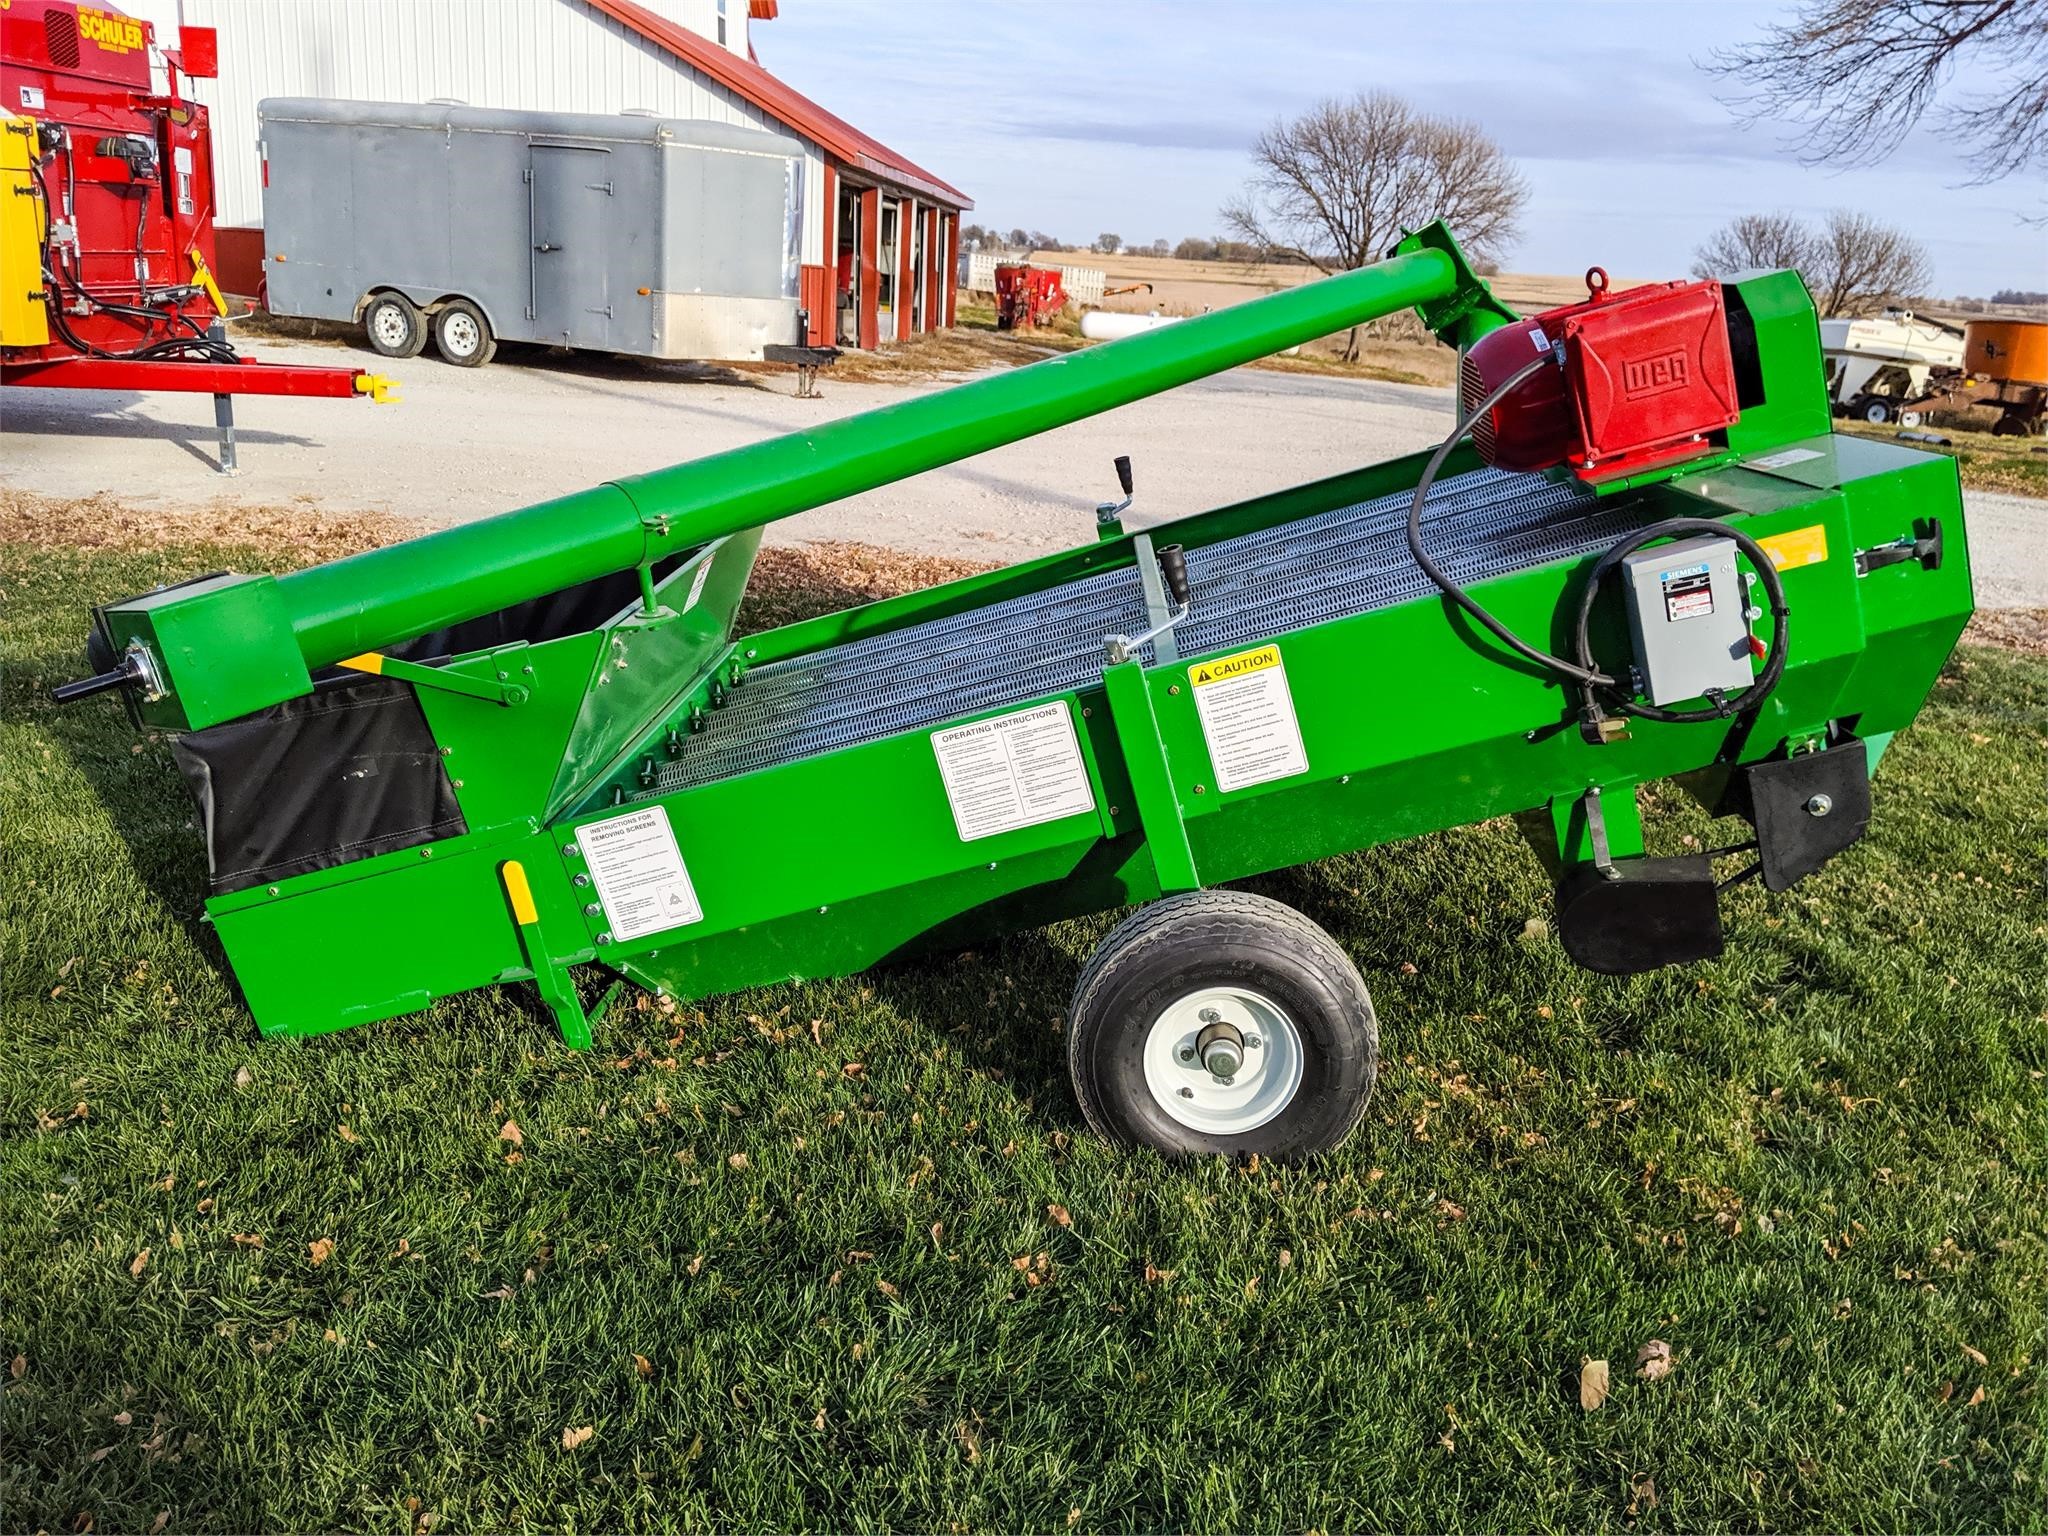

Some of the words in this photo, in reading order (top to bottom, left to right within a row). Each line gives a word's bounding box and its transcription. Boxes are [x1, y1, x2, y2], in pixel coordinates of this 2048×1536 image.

[79, 14, 144, 51] SCHULER
[1667, 566, 1702, 579] SIEMENS
[1214, 653, 1273, 677] CAUTION
[942, 725, 992, 743] OPERATING
[994, 708, 1058, 730] INSTRUCTIONS
[590, 818, 637, 834] INSTRUCTIONS
[638, 813, 652, 822] FOR
[591, 829, 625, 842] REMOVING
[626, 820, 656, 833] SCREENS
